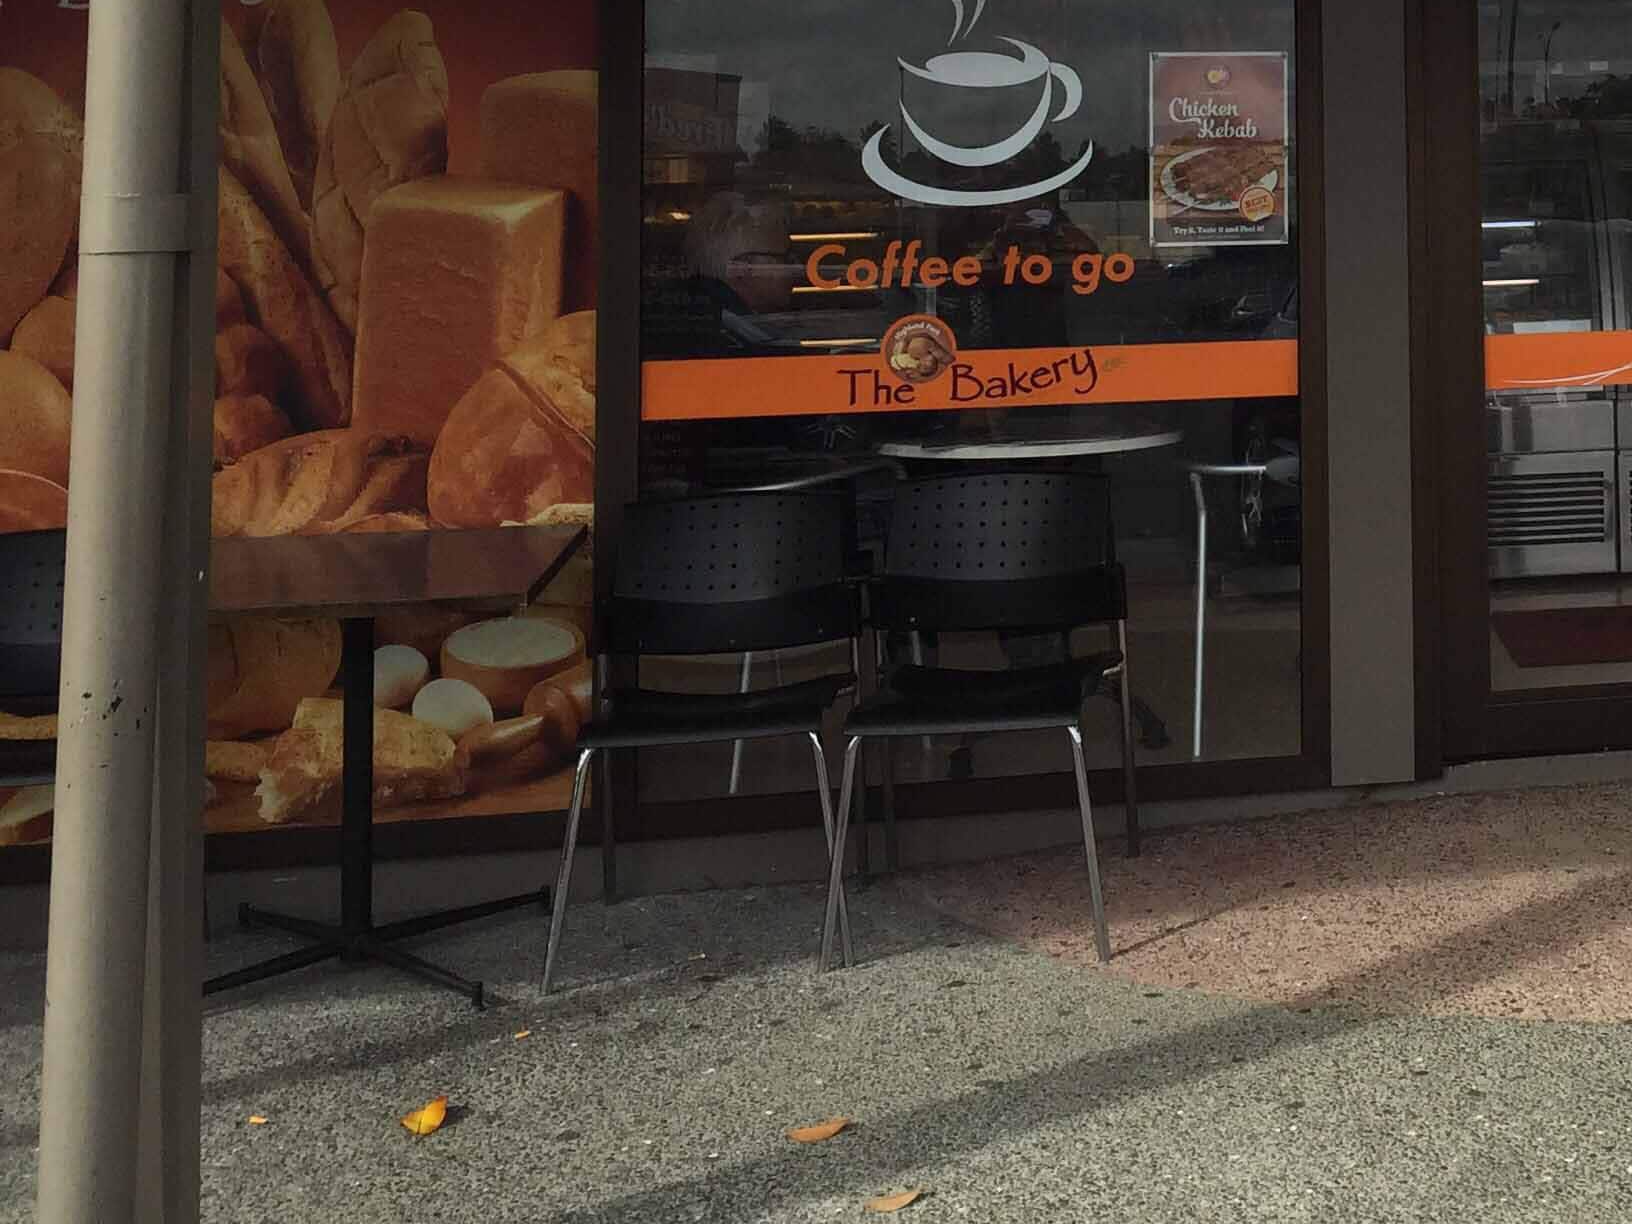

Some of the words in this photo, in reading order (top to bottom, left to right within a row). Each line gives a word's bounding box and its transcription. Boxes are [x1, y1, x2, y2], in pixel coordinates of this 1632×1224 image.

[1168, 96, 1240, 123] Chicken
[1197, 118, 1258, 139] Kebab
[805, 239, 982, 289] Coffee
[1003, 244, 1052, 286] to
[1072, 251, 1135, 295] go
[837, 367, 915, 406] The
[950, 348, 1098, 402] Bakery
